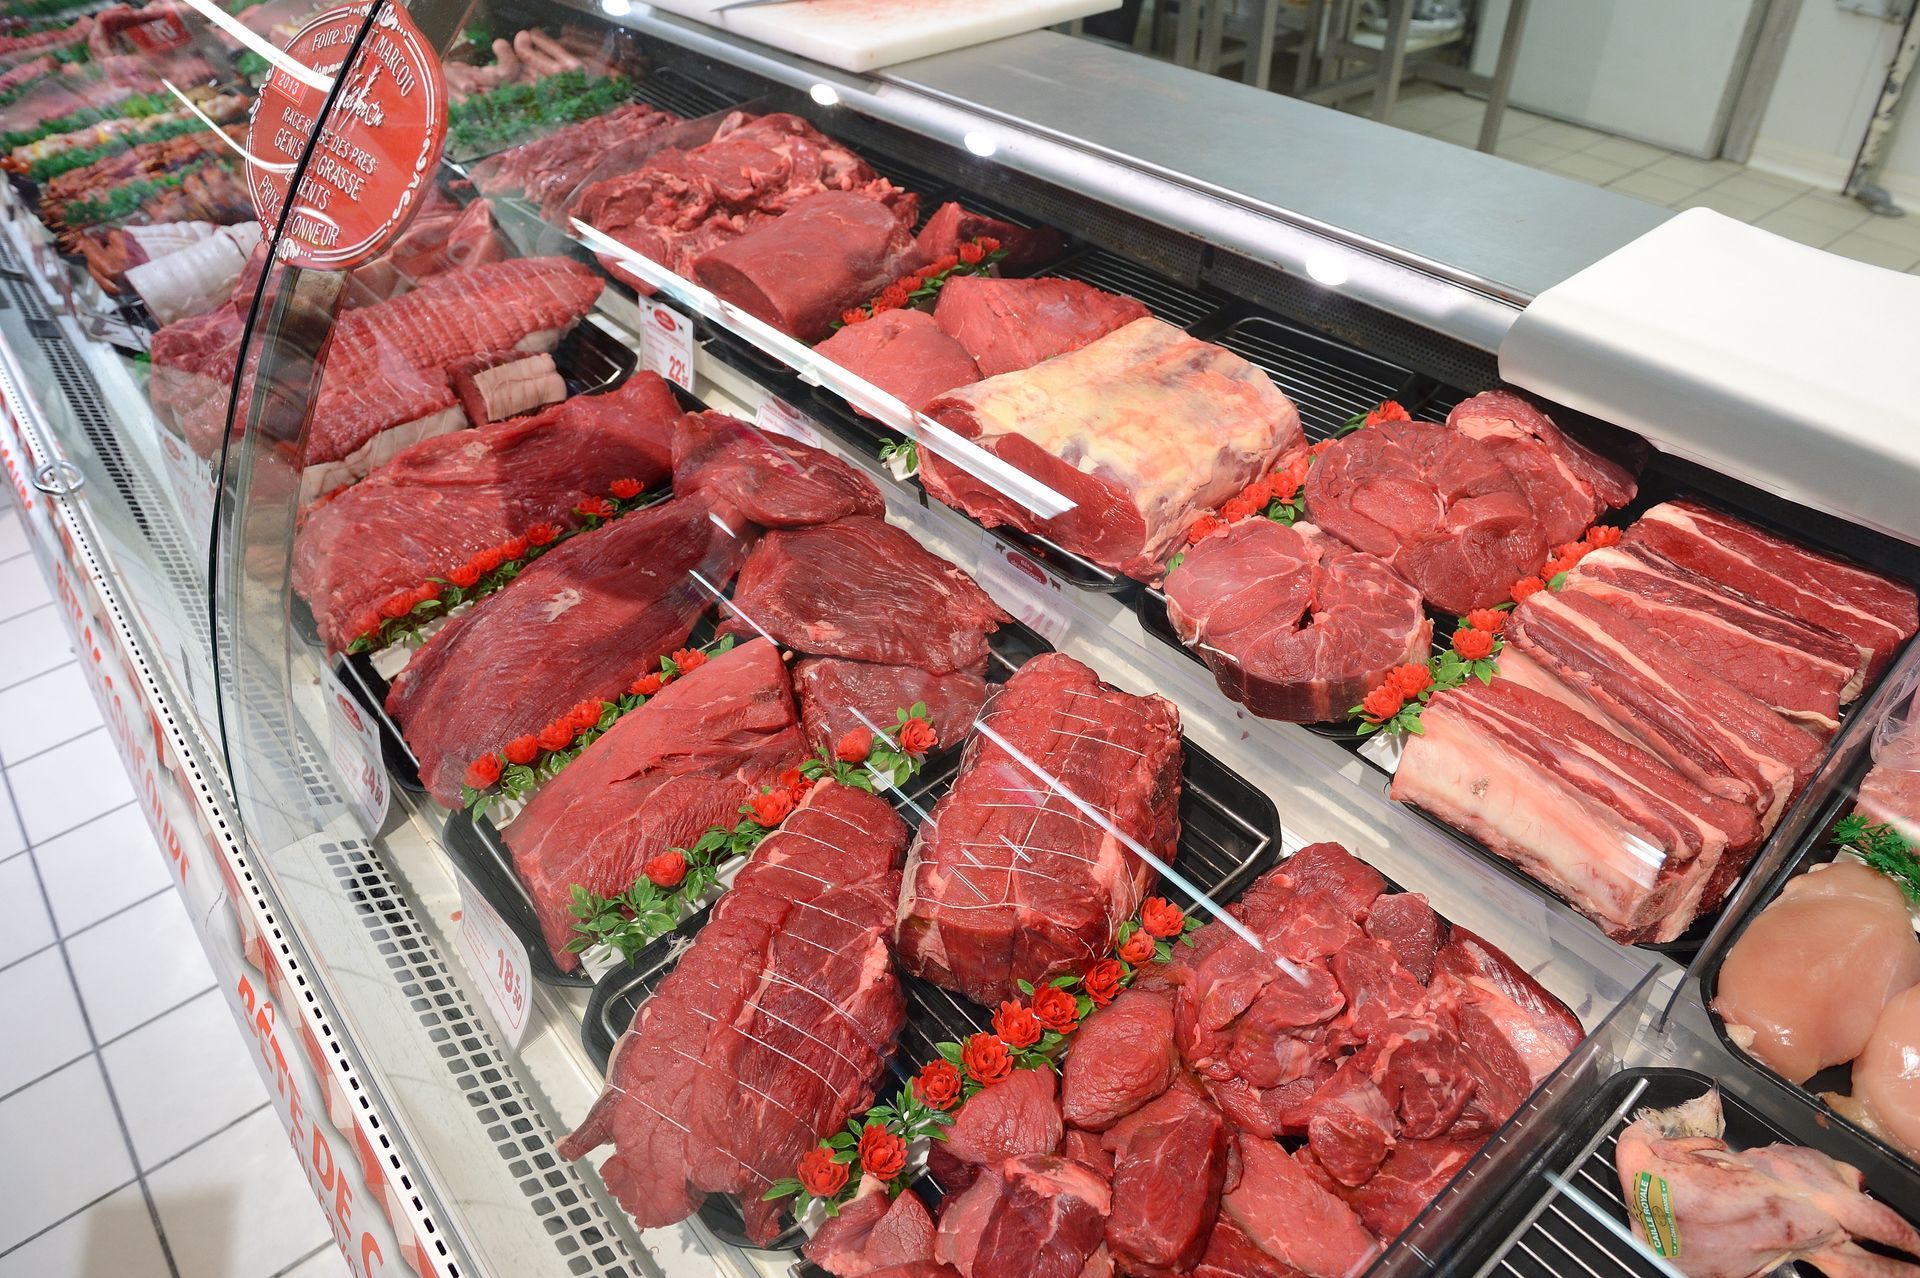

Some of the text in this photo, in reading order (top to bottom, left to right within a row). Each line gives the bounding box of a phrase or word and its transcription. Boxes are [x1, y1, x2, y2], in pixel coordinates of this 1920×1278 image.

[277, 73, 300, 95] 2013
[374, 34, 416, 97] MARCOU
[281, 106, 305, 130] RACE
[330, 135, 351, 159] DES
[258, 174, 280, 214] PRIX
[297, 175, 331, 210] ENTS
[316, 155, 365, 201] GRASSE
[312, 1120, 353, 1242] DE
[1639, 1179, 1662, 1249] CAILLE ROYALE
